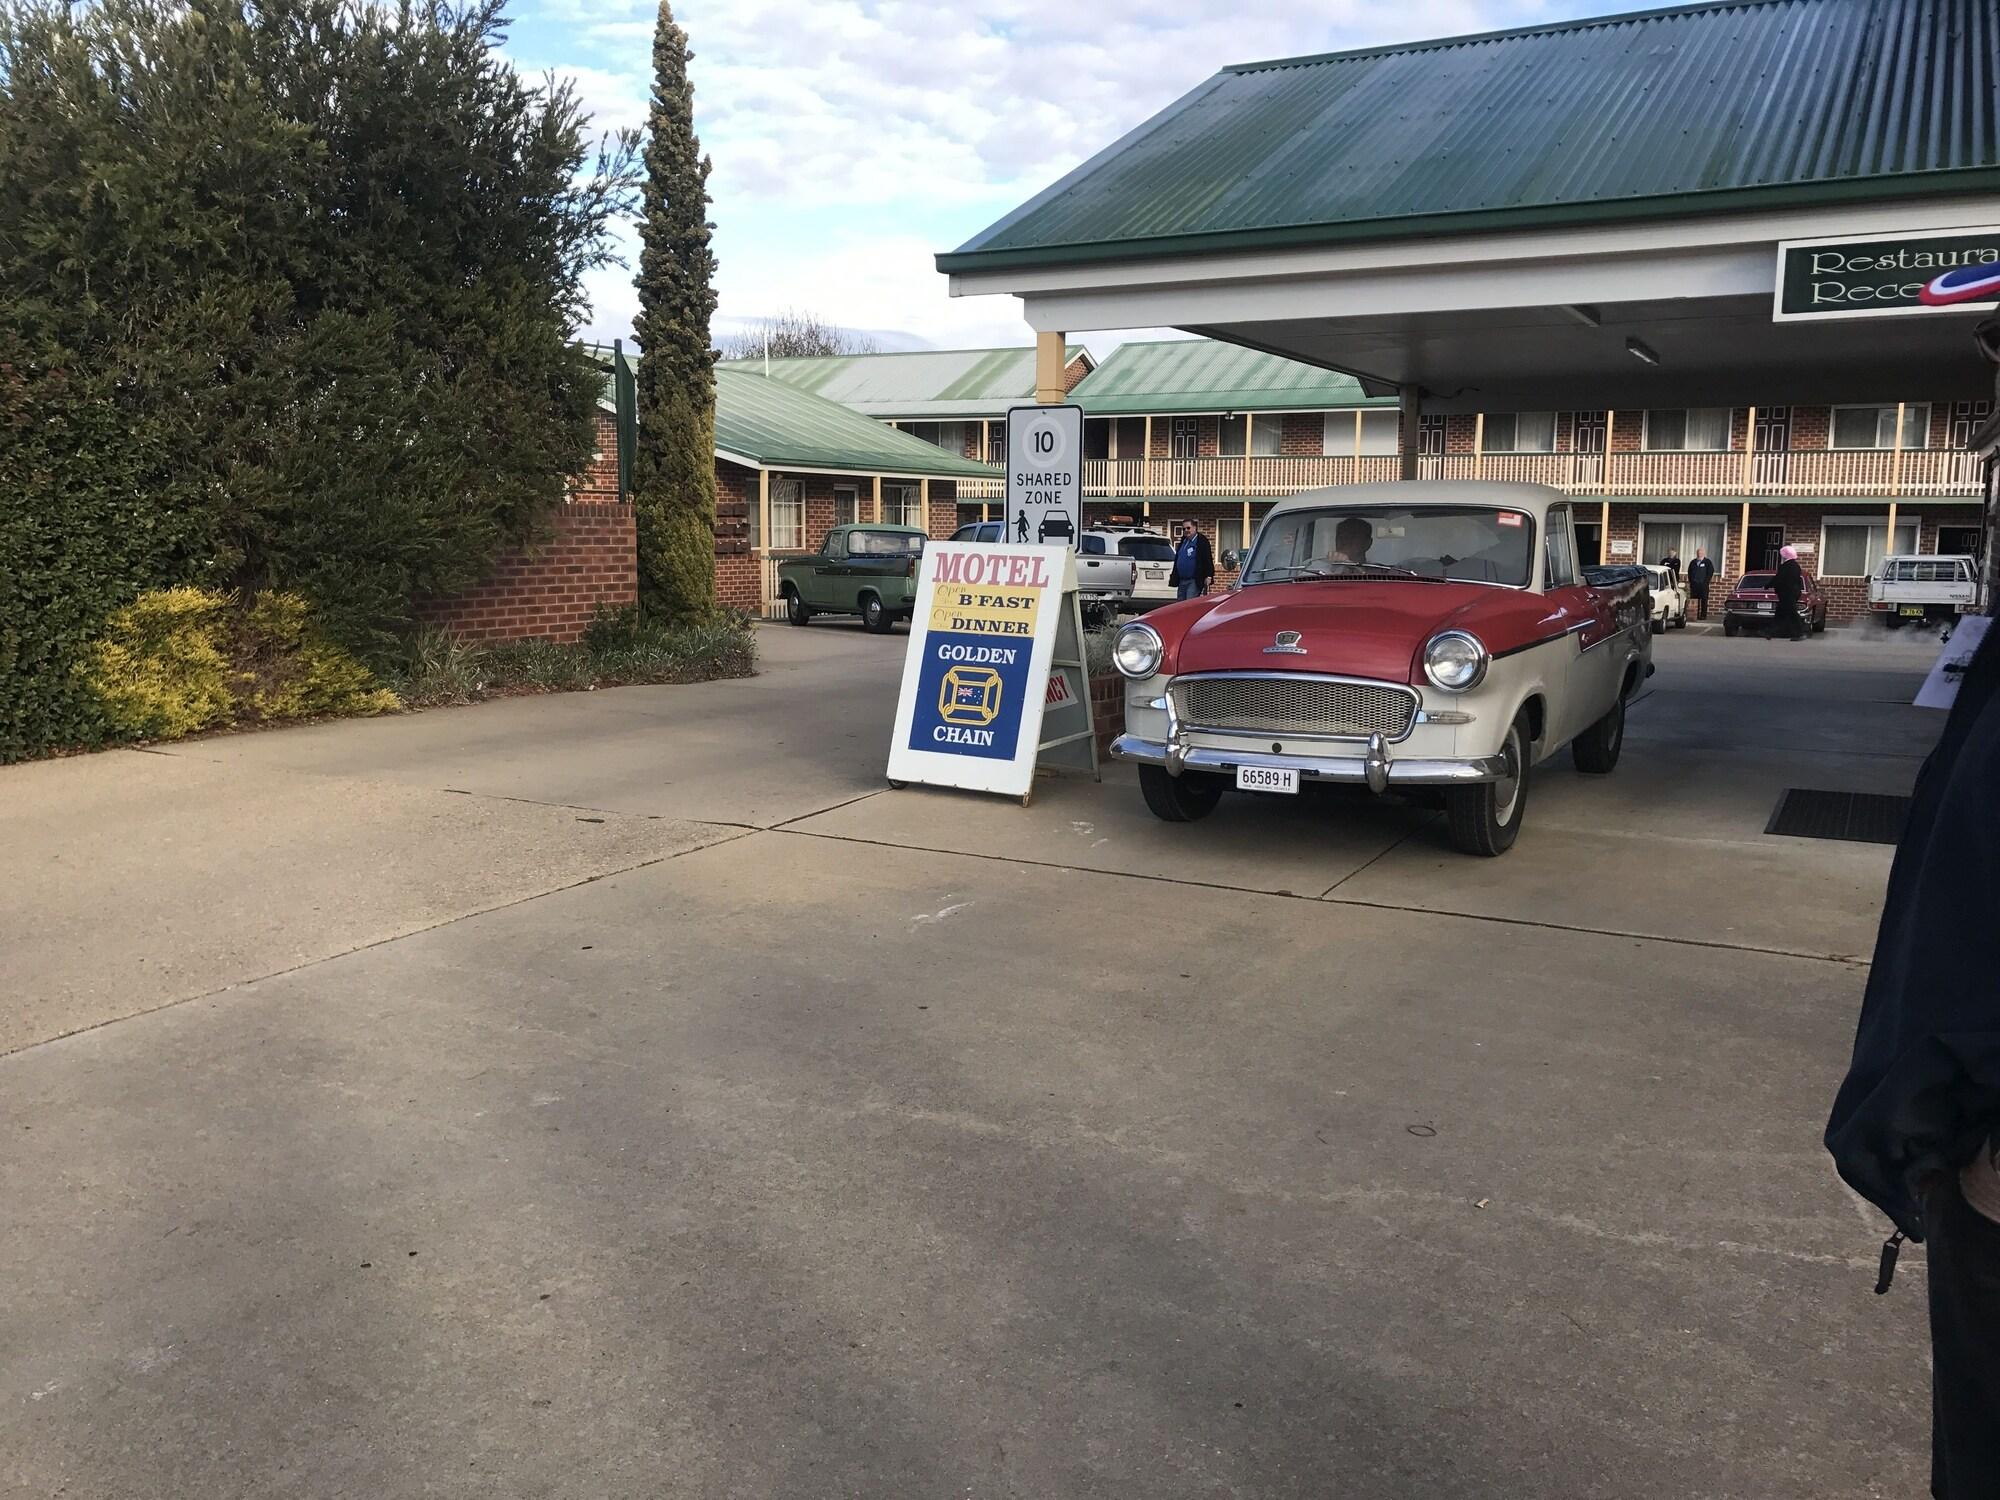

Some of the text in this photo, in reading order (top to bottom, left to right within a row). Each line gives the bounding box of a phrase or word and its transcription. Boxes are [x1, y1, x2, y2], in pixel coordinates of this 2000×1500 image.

[1034, 431, 1054, 453] 10
[1016, 472, 1072, 486] SHARED
[1025, 491, 1062, 504] ZONE
[932, 552, 1050, 588] MOTEL
[937, 584, 966, 597] Open
[933, 608, 962, 621] Open
[950, 617, 1030, 635] DINNER
[938, 644, 1017, 664] GOLDEN
[933, 725, 995, 747] CHAIN
